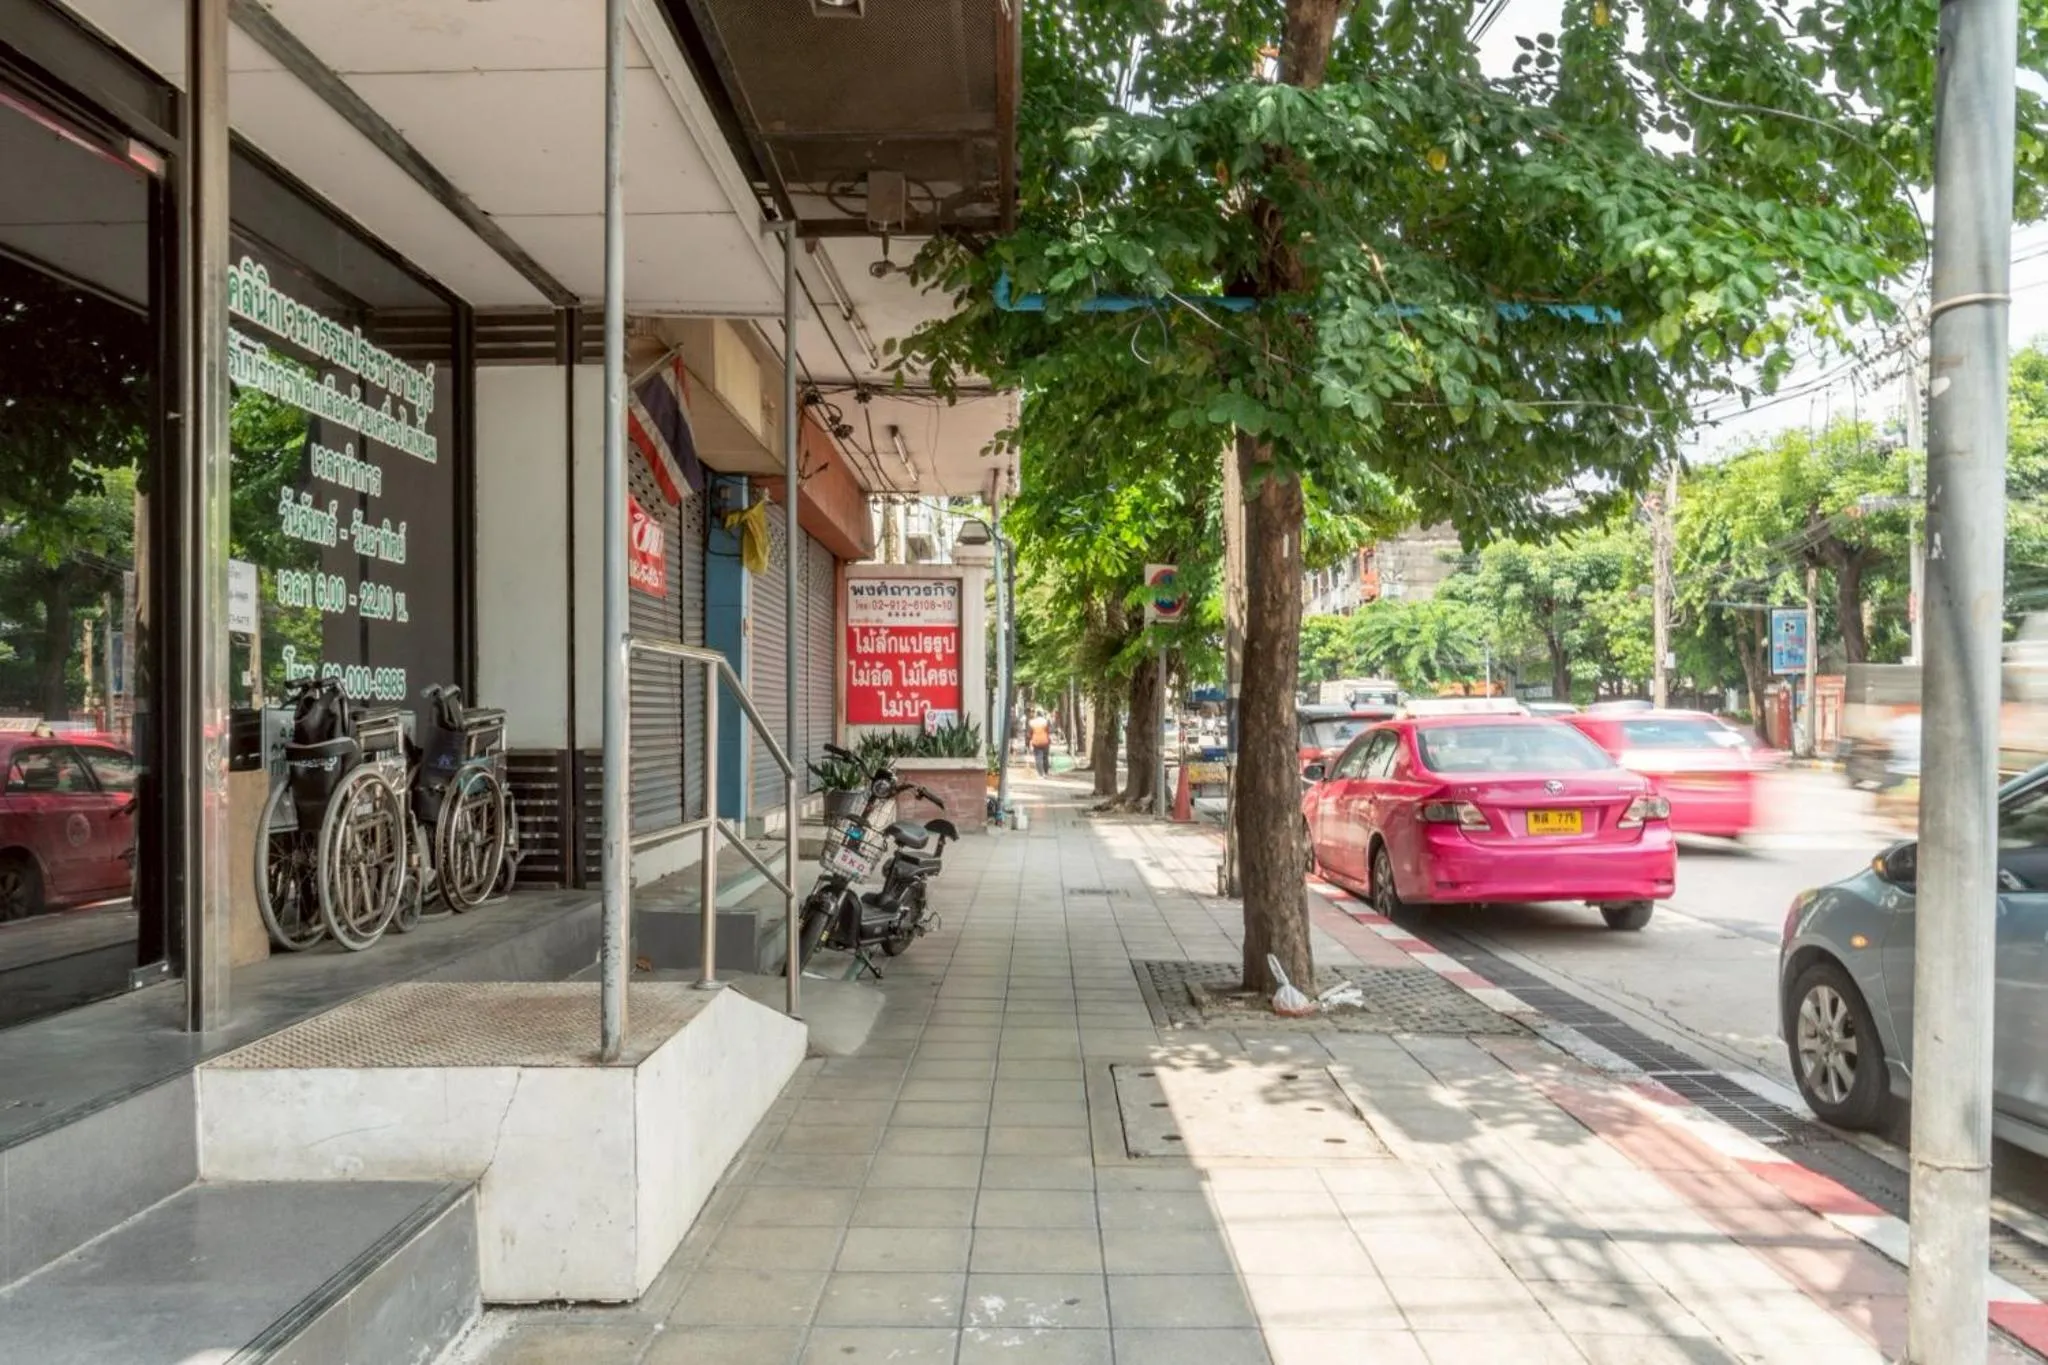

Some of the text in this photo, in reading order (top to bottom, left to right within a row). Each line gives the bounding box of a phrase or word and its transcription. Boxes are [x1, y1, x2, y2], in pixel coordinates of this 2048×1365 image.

[311, 443, 383, 497] เวลาทำการ
[278, 486, 338, 547] วันจันทร์
[351, 508, 407, 564] วันอาทิตย์
[278, 569, 314, 607] เวลา
[315, 572, 347, 614] 6.00
[359, 581, 393, 620] 22.00
[395, 591, 409, 623] น.
[853, 627, 956, 661] ไม้สักแปรรูป
[849, 659, 893, 687] ไม้อัด
